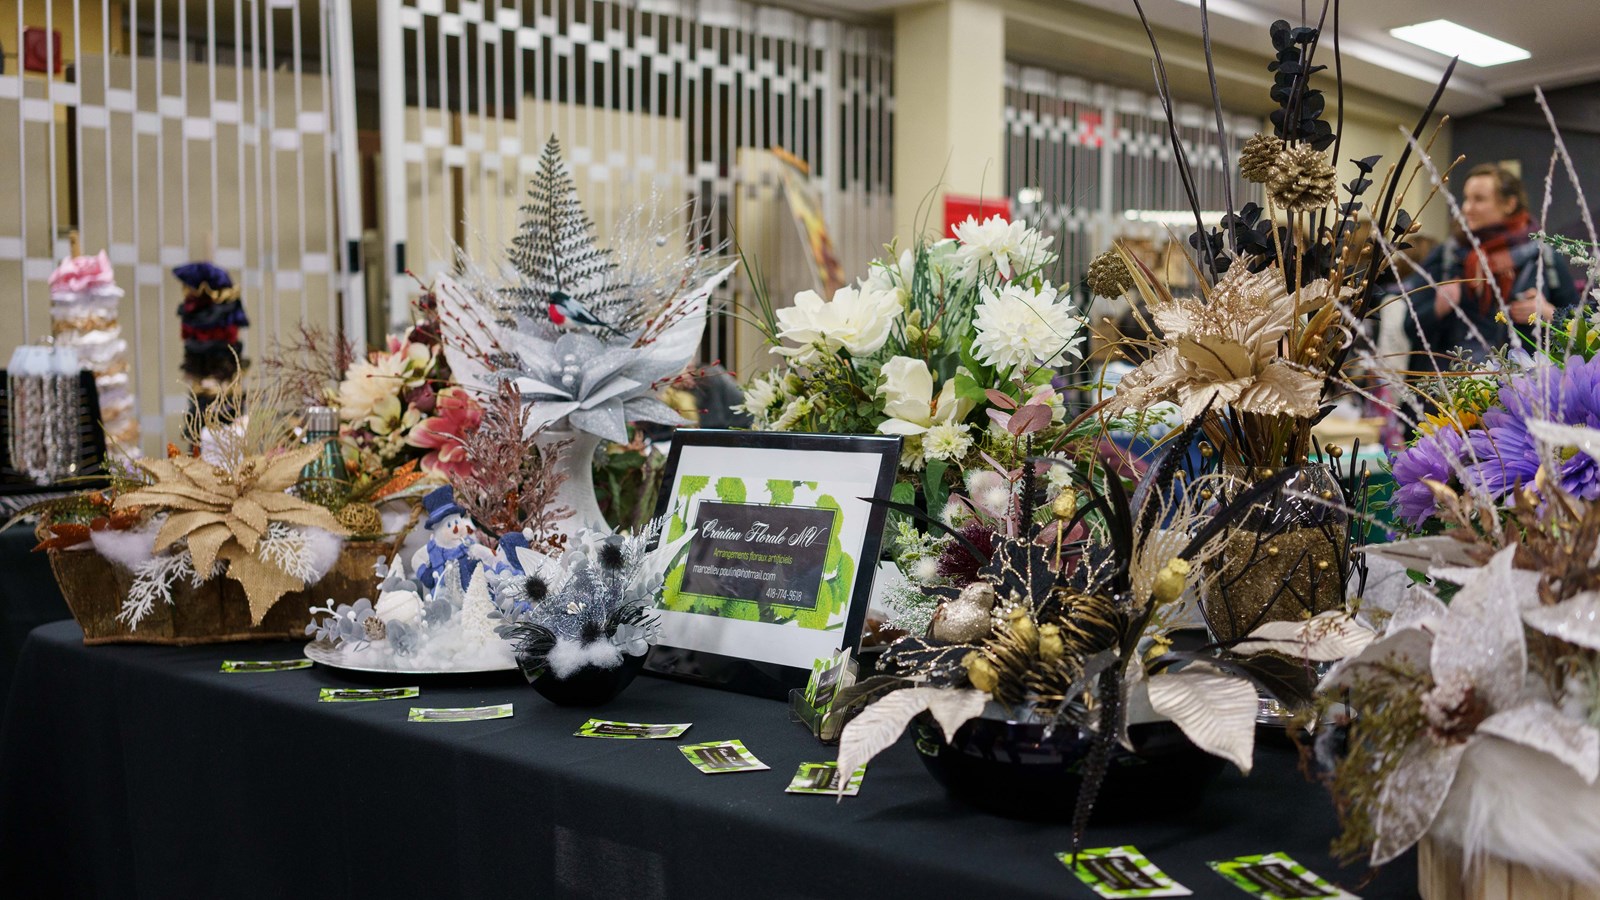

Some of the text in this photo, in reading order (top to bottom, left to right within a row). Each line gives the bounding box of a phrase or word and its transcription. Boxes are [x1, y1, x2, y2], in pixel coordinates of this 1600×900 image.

[702, 518, 828, 548] Création Florale MV
[713, 547, 750, 561] Arrangements
[749, 551, 767, 562] floraux
